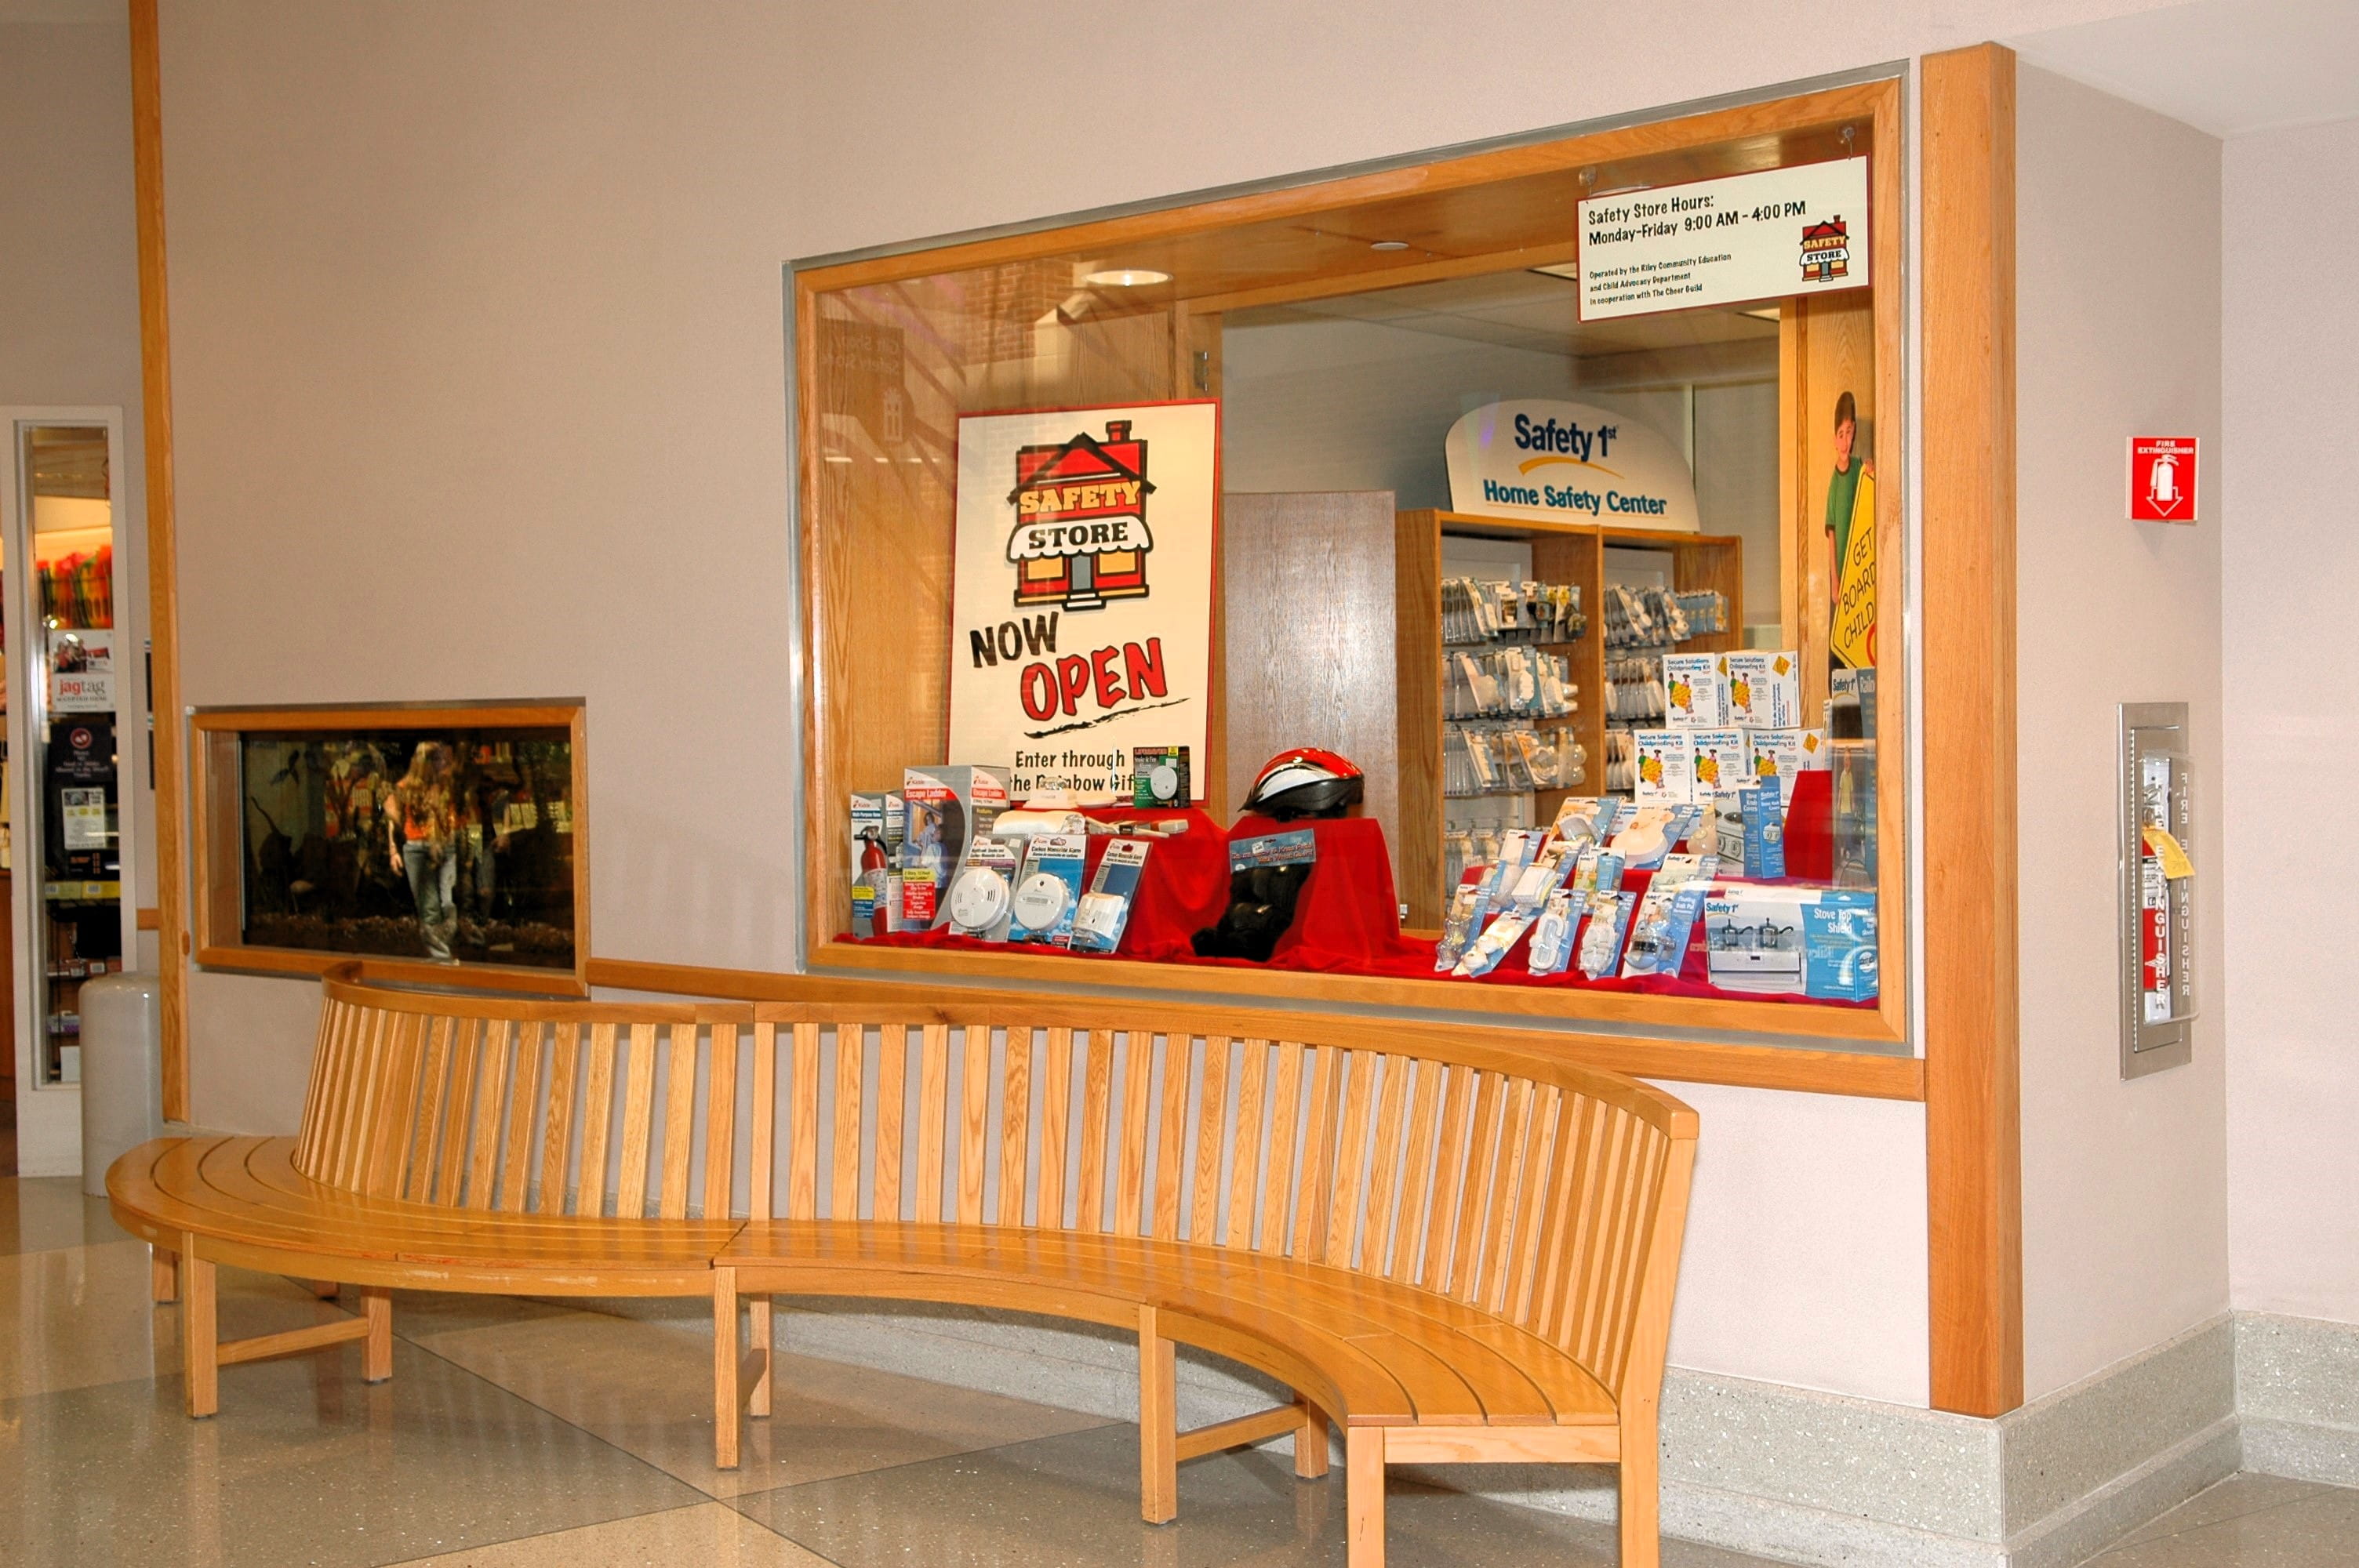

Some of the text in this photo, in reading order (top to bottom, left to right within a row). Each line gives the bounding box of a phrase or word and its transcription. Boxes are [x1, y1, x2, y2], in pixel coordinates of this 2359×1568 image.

[1589, 195, 1714, 225] Safety Store Hours:
[1589, 221, 1678, 246] Monday-Friday
[1685, 214, 1712, 231] 9:00
[1716, 211, 1739, 227] AM
[1751, 204, 1780, 222] 4:00
[1784, 201, 1806, 217] PM
[1804, 235, 1845, 249] SAFETY
[1590, 268, 1618, 280] Operated
[1629, 265, 1640, 274] the
[1659, 258, 1696, 270] Community
[1698, 254, 1732, 264] Education
[1807, 250, 1841, 261] STORE
[1603, 281, 1619, 290] Child
[1620, 278, 1652, 288] Advocacy
[1653, 272, 1691, 284] Department
[1598, 293, 1635, 304] cooperation
[1685, 283, 1702, 292] Guild
[1514, 413, 1617, 462] Safety 1st
[1020, 481, 1141, 514] SAFETY
[1483, 479, 1667, 516] Home Safety Center
[1028, 521, 1128, 550] STORE
[1853, 527, 1871, 566] GET
[1843, 561, 1875, 615] BOARD
[1845, 601, 1874, 649] CHILD
[969, 611, 1060, 669] NOW
[60, 680, 105, 696] jagtag
[1020, 637, 1168, 721] OPEN
[1834, 678, 1850, 692] Safety
[1016, 750, 1125, 771] Enter through
[906, 789, 925, 799] Escape
[1010, 774, 1031, 792] he
[1706, 902, 1730, 914] Safety
[1814, 908, 1852, 922] Stove Top
[1828, 922, 1852, 934] Shield
